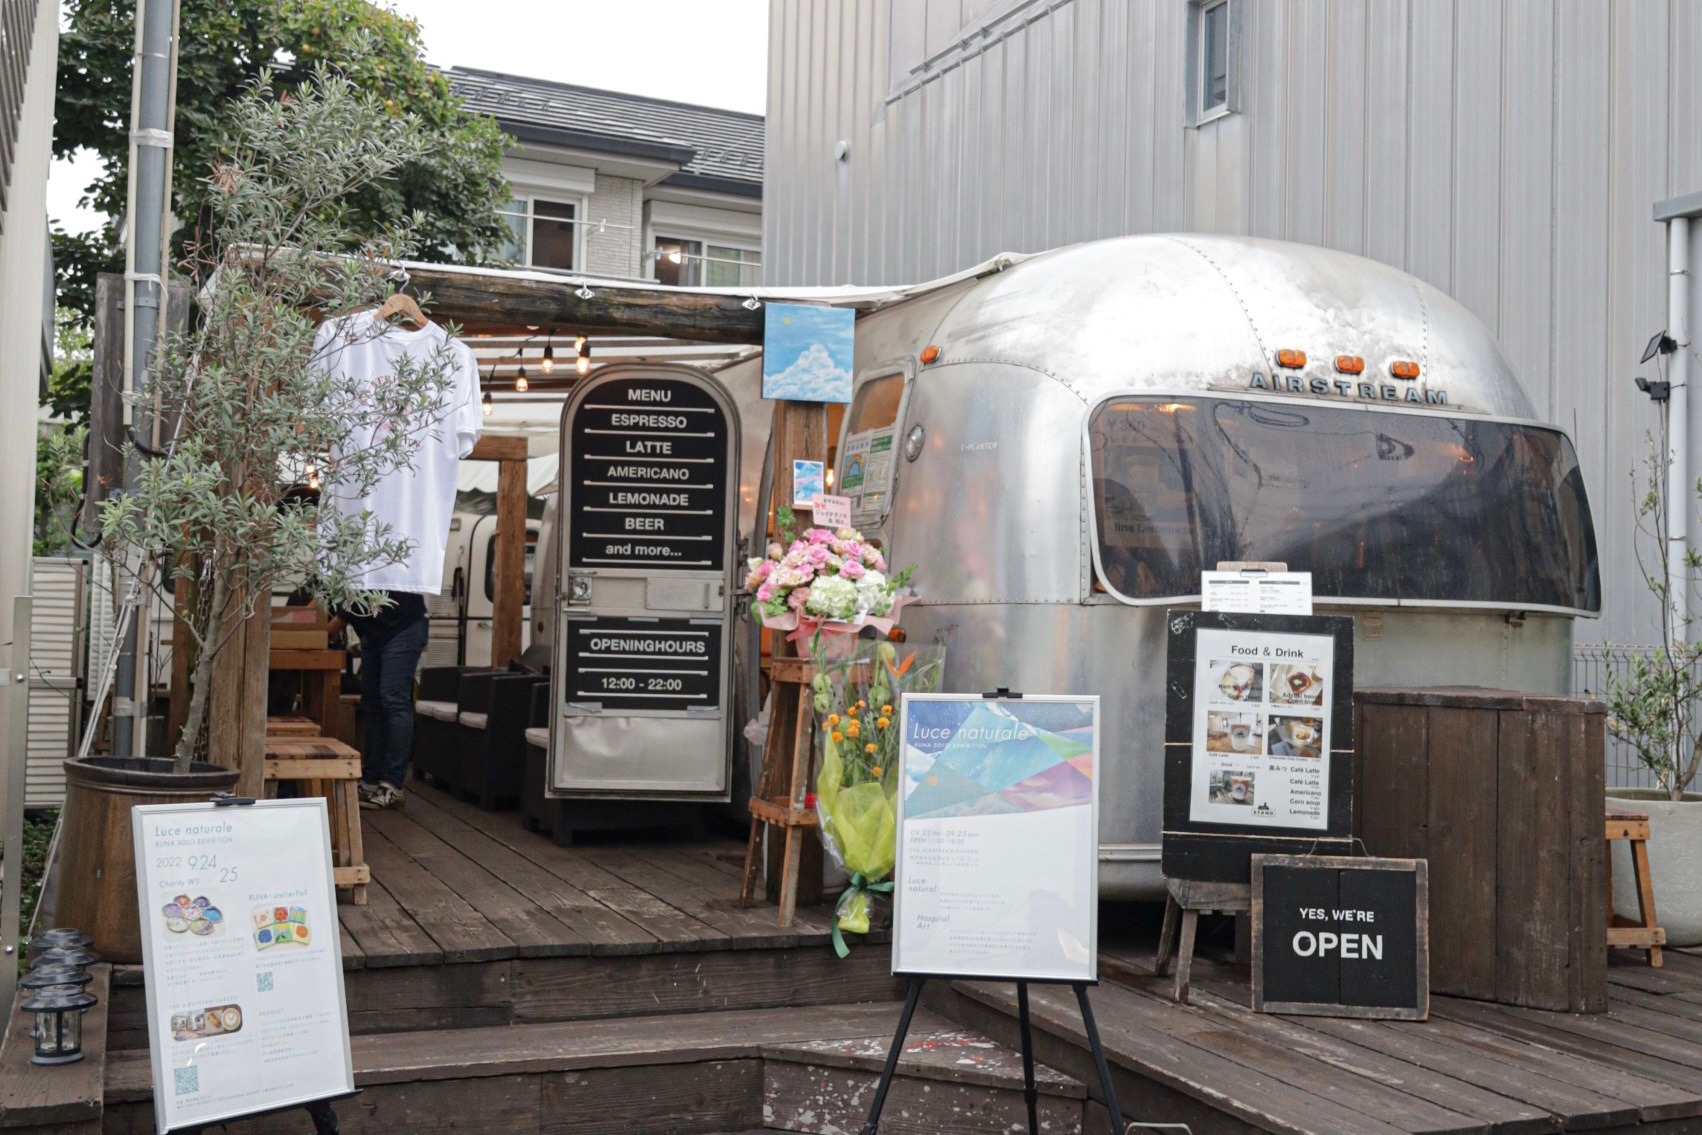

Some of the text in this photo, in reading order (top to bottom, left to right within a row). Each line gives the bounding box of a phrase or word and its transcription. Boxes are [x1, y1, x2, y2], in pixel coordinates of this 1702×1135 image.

[627, 388, 672, 402] MENU
[1250, 372, 1449, 405] AIRSTREAM
[611, 413, 688, 429] ESPRESSO
[625, 440, 672, 454] LATTE
[607, 466, 690, 480] AMERICANO
[608, 492, 689, 506] LEMONADE
[624, 517, 665, 531] BEER
[605, 543, 631, 556] and
[1231, 645, 1304, 659] Food & Drink
[601, 677, 636, 690] 12:00
[647, 679, 682, 691] 22:00
[913, 723, 1029, 741] Luce naturale
[155, 820, 233, 837] Luce naturale
[155, 856, 181, 868] 2022
[219, 867, 239, 883] 25
[908, 876, 926, 884] Luce
[917, 914, 950, 924] Hospital
[1299, 907, 1329, 922] YES,
[917, 922, 930, 930] Art
[1292, 930, 1384, 960] OPEN
